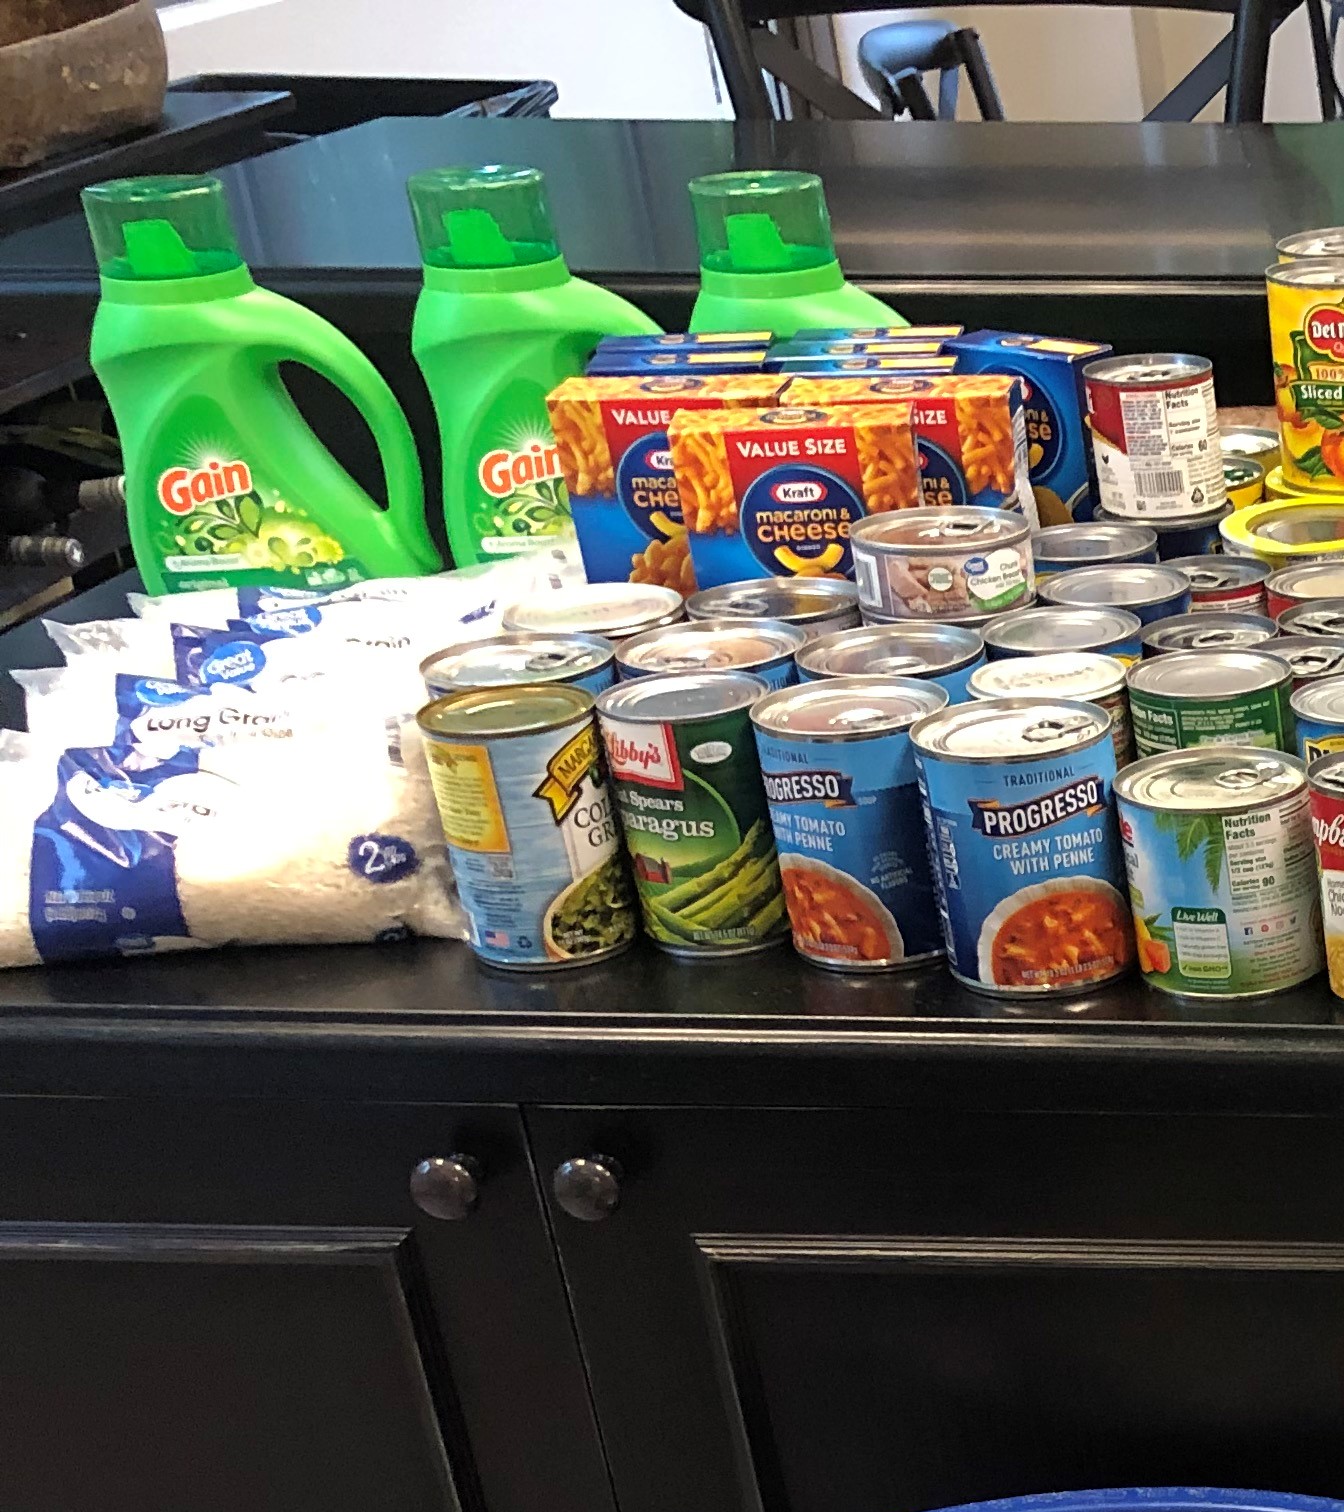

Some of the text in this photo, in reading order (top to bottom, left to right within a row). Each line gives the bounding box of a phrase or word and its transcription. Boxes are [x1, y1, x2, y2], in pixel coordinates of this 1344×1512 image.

[1311, 322, 1335, 339] Del
[1300, 384, 1342, 400] Sliced
[611, 408, 672, 427] VALUE
[736, 437, 847, 458] VALUE SIZE
[480, 443, 562, 499] Gain
[159, 459, 252, 512] Gain
[782, 484, 816, 500] Kraft
[756, 507, 838, 523] macaroni
[146, 711, 211, 732] Long
[1003, 765, 1076, 788] TRADITIONAL
[629, 793, 684, 812] Spears
[983, 781, 1098, 836] PROGRESSO
[795, 815, 846, 836] TOMATO
[1224, 813, 1272, 829] Nutrition
[796, 832, 834, 852] PENNE
[992, 827, 1104, 861] CREAMY TOMATO
[1225, 827, 1256, 841] Facts
[358, 842, 386, 875] 2
[1009, 850, 1095, 876] WITH PENNE
